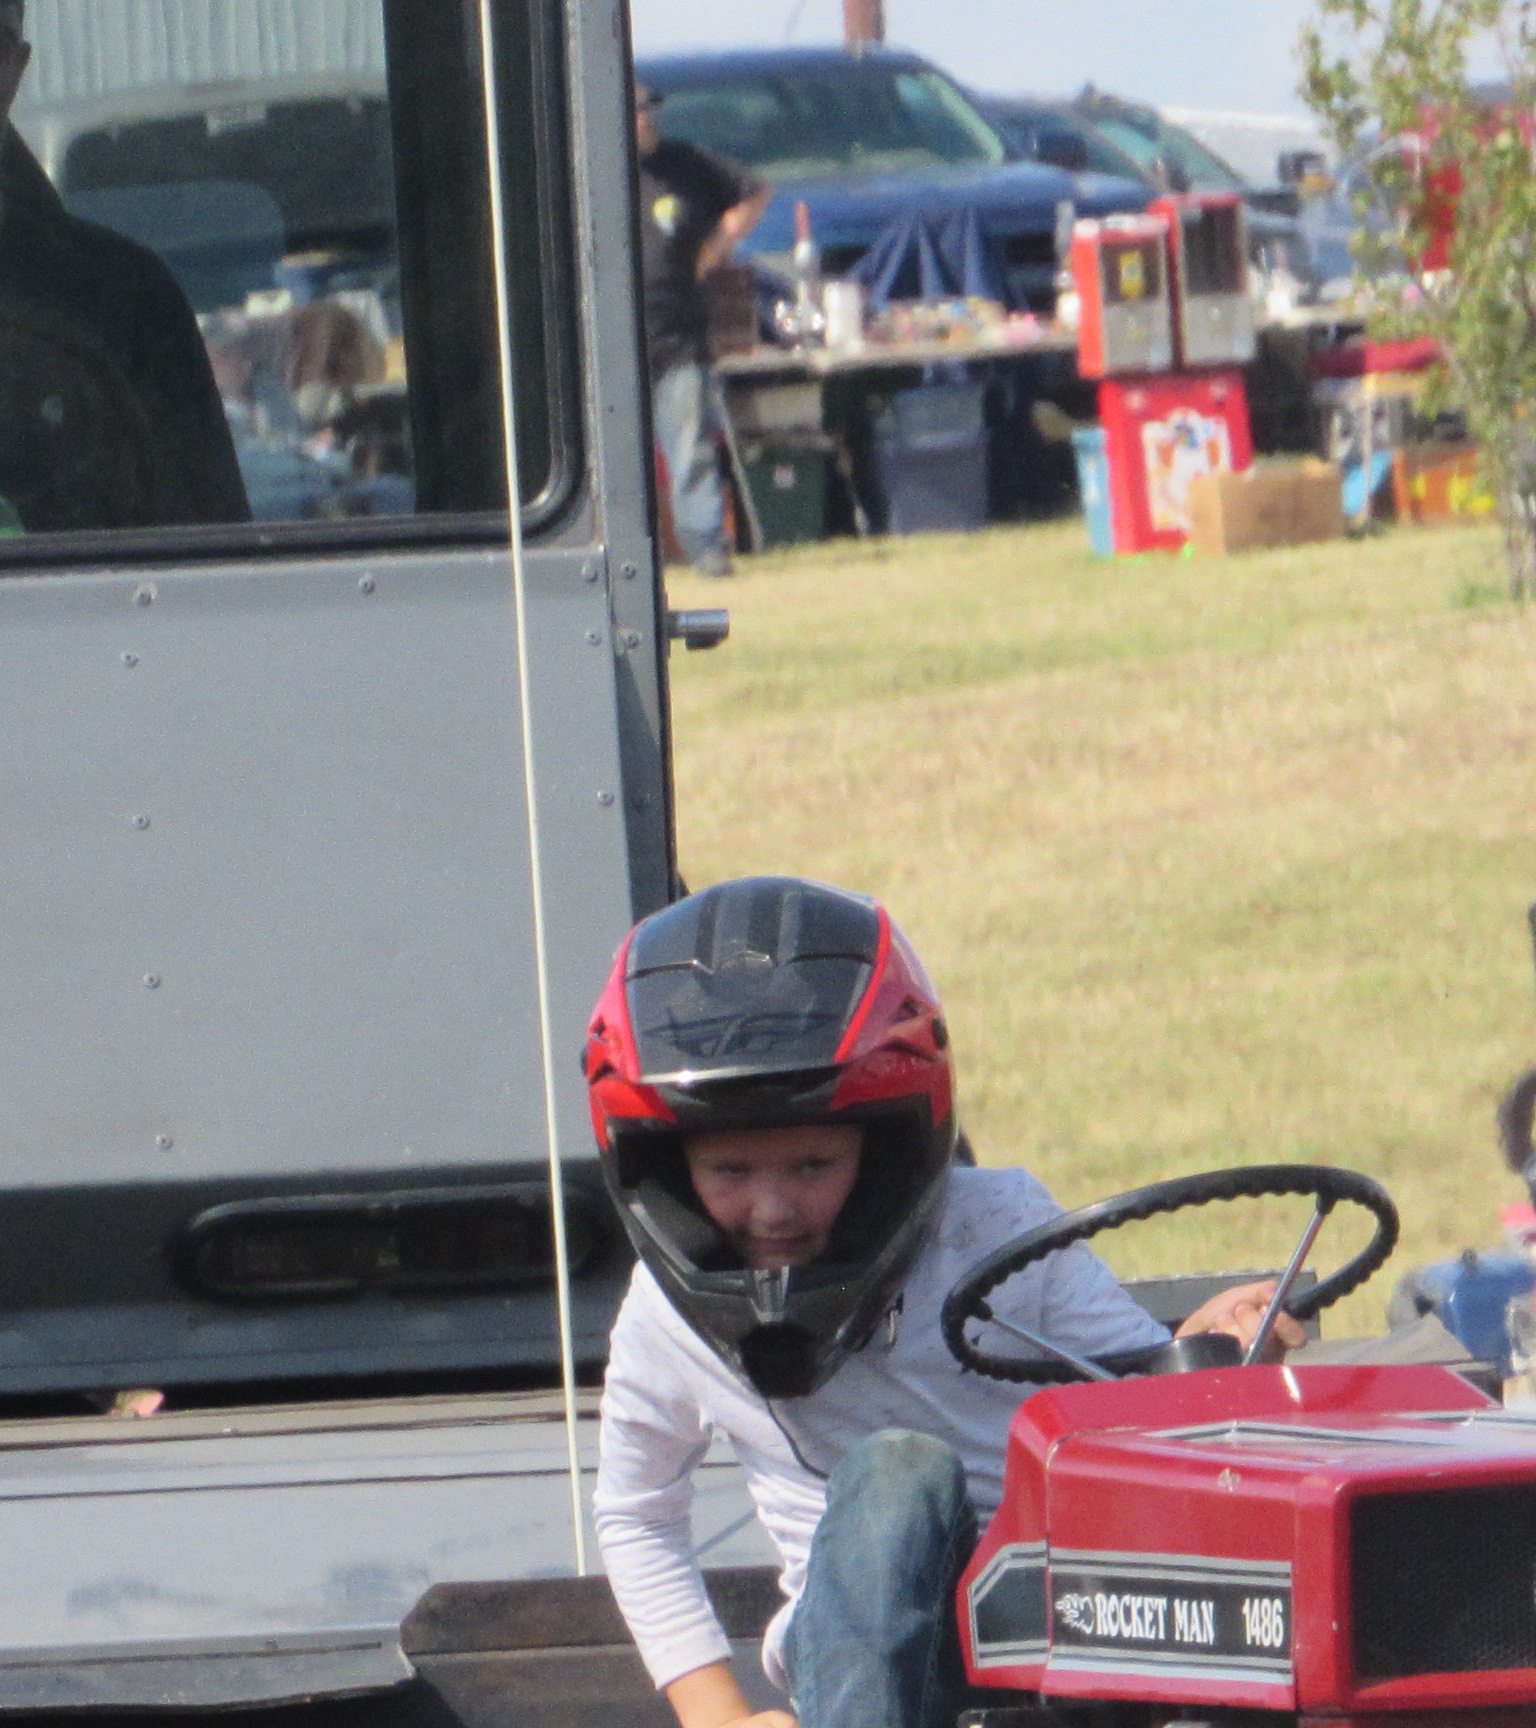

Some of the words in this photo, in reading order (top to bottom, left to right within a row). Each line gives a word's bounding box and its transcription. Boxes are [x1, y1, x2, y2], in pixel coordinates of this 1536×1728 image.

[1095, 1593, 1168, 1640] ROCKET
[1173, 1598, 1216, 1645] MAN
[1241, 1598, 1284, 1647] 1486
